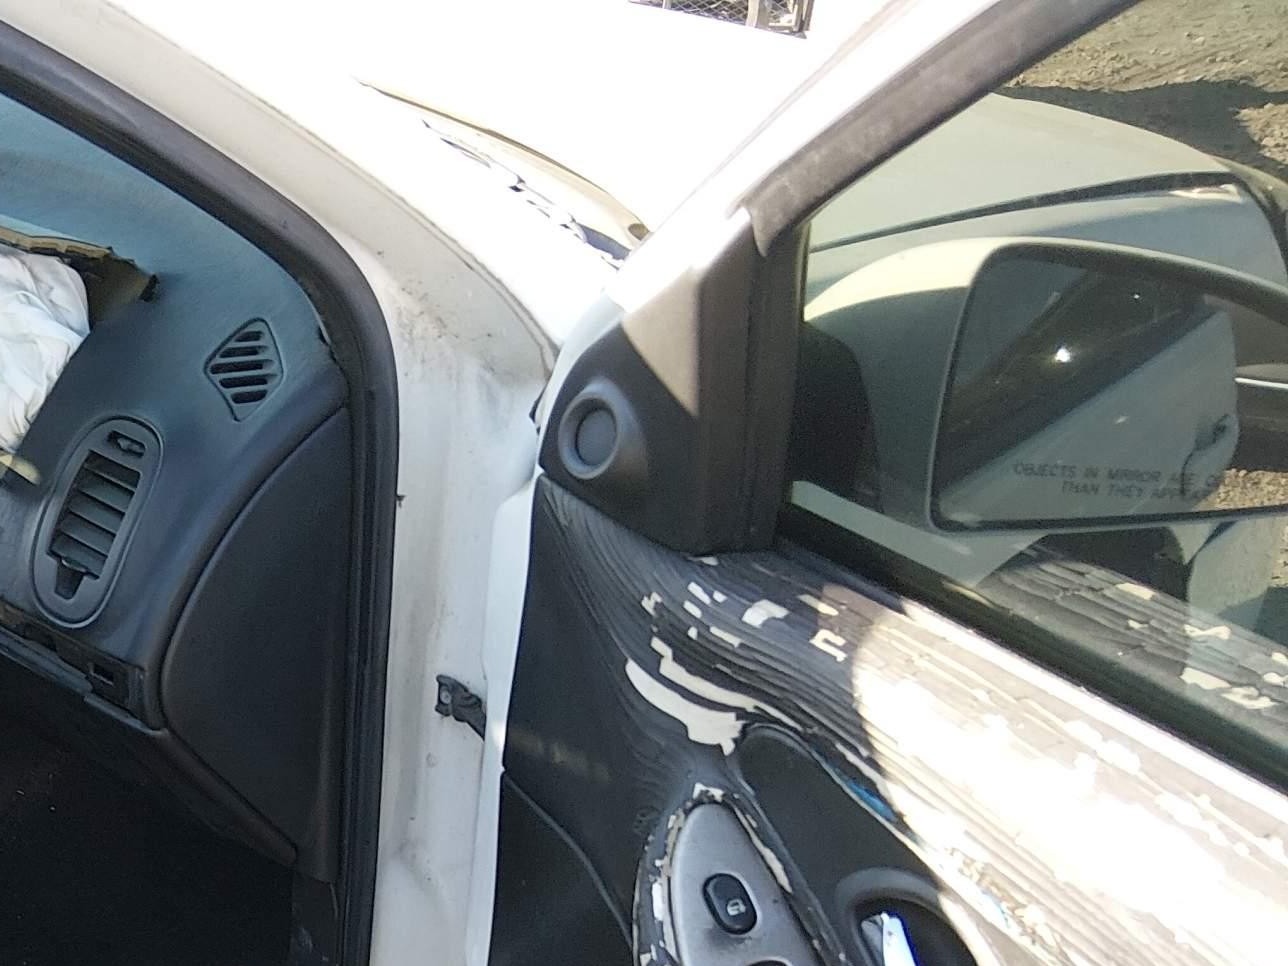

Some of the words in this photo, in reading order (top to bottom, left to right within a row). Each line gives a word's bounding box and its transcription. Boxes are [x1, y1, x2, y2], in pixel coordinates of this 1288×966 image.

[1014, 463, 1076, 479] OBJECTS
[1084, 466, 1099, 479] IN
[1108, 469, 1161, 482] MIRROR
[1062, 480, 1099, 496] THAN
[1108, 484, 1143, 498] THEY
